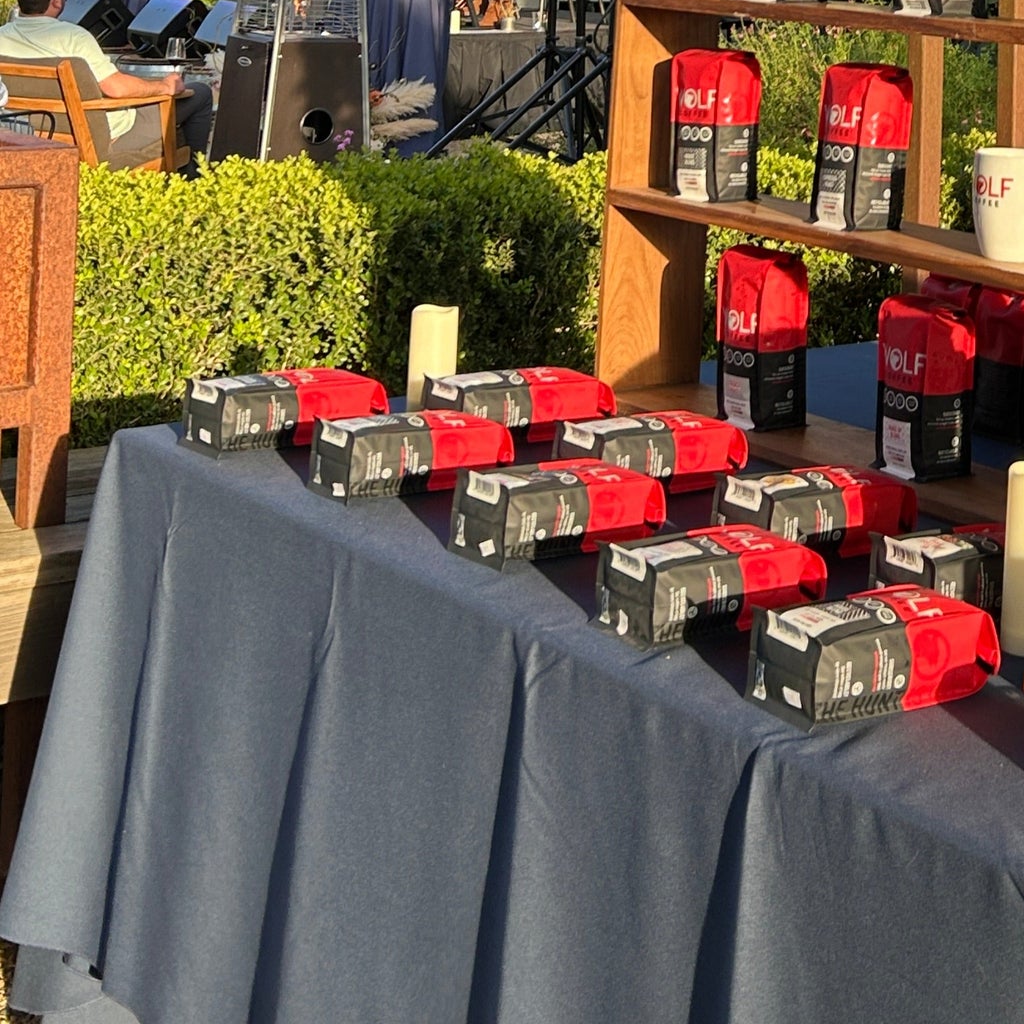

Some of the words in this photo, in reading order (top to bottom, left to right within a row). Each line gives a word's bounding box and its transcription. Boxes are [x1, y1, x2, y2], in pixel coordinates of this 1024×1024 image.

[976, 174, 1014, 198] OLF
[726, 530, 776, 552] OLF
[893, 590, 944, 617] OLF
